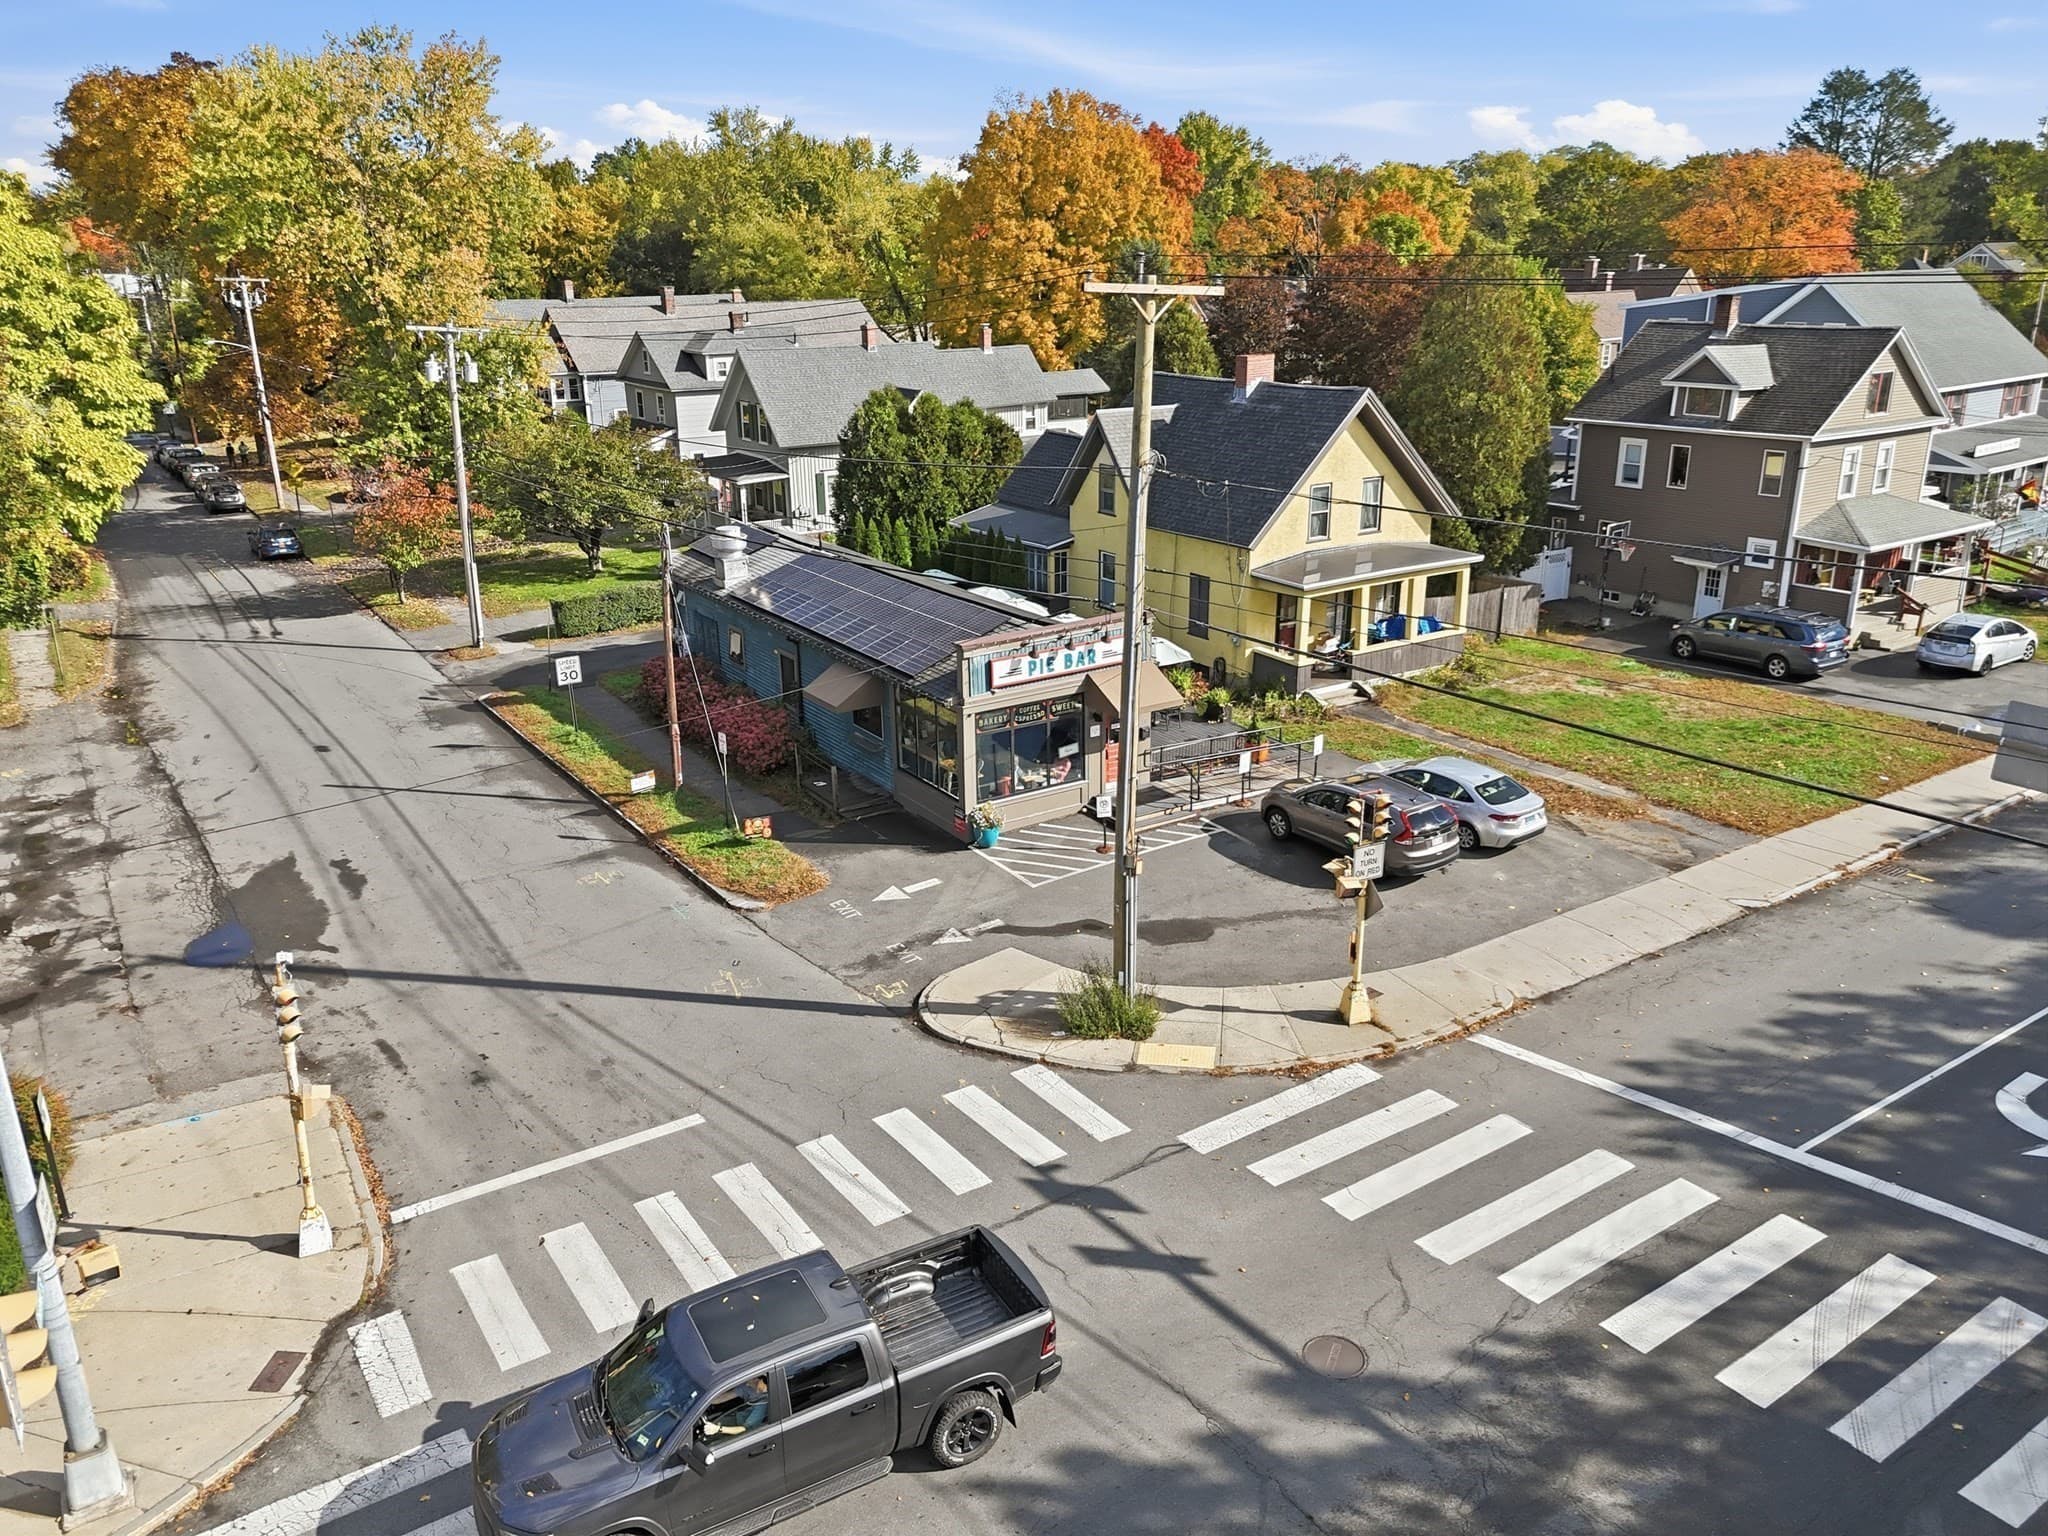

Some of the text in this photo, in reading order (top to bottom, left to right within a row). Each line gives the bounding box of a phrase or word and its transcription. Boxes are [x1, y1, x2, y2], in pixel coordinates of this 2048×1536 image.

[1028, 649, 1096, 677] PIE BAR
[560, 670, 578, 681] 30
[1019, 704, 1041, 713] COFFEE
[1051, 701, 1081, 712] SWEET
[979, 714, 1008, 727] BAKERY
[1014, 711, 1046, 721] ESPRESSO
[1364, 848, 1375, 857] NO
[1360, 858, 1377, 866] TURN
[1355, 866, 1380, 878] ON RED
[829, 899, 863, 919] EXIT
